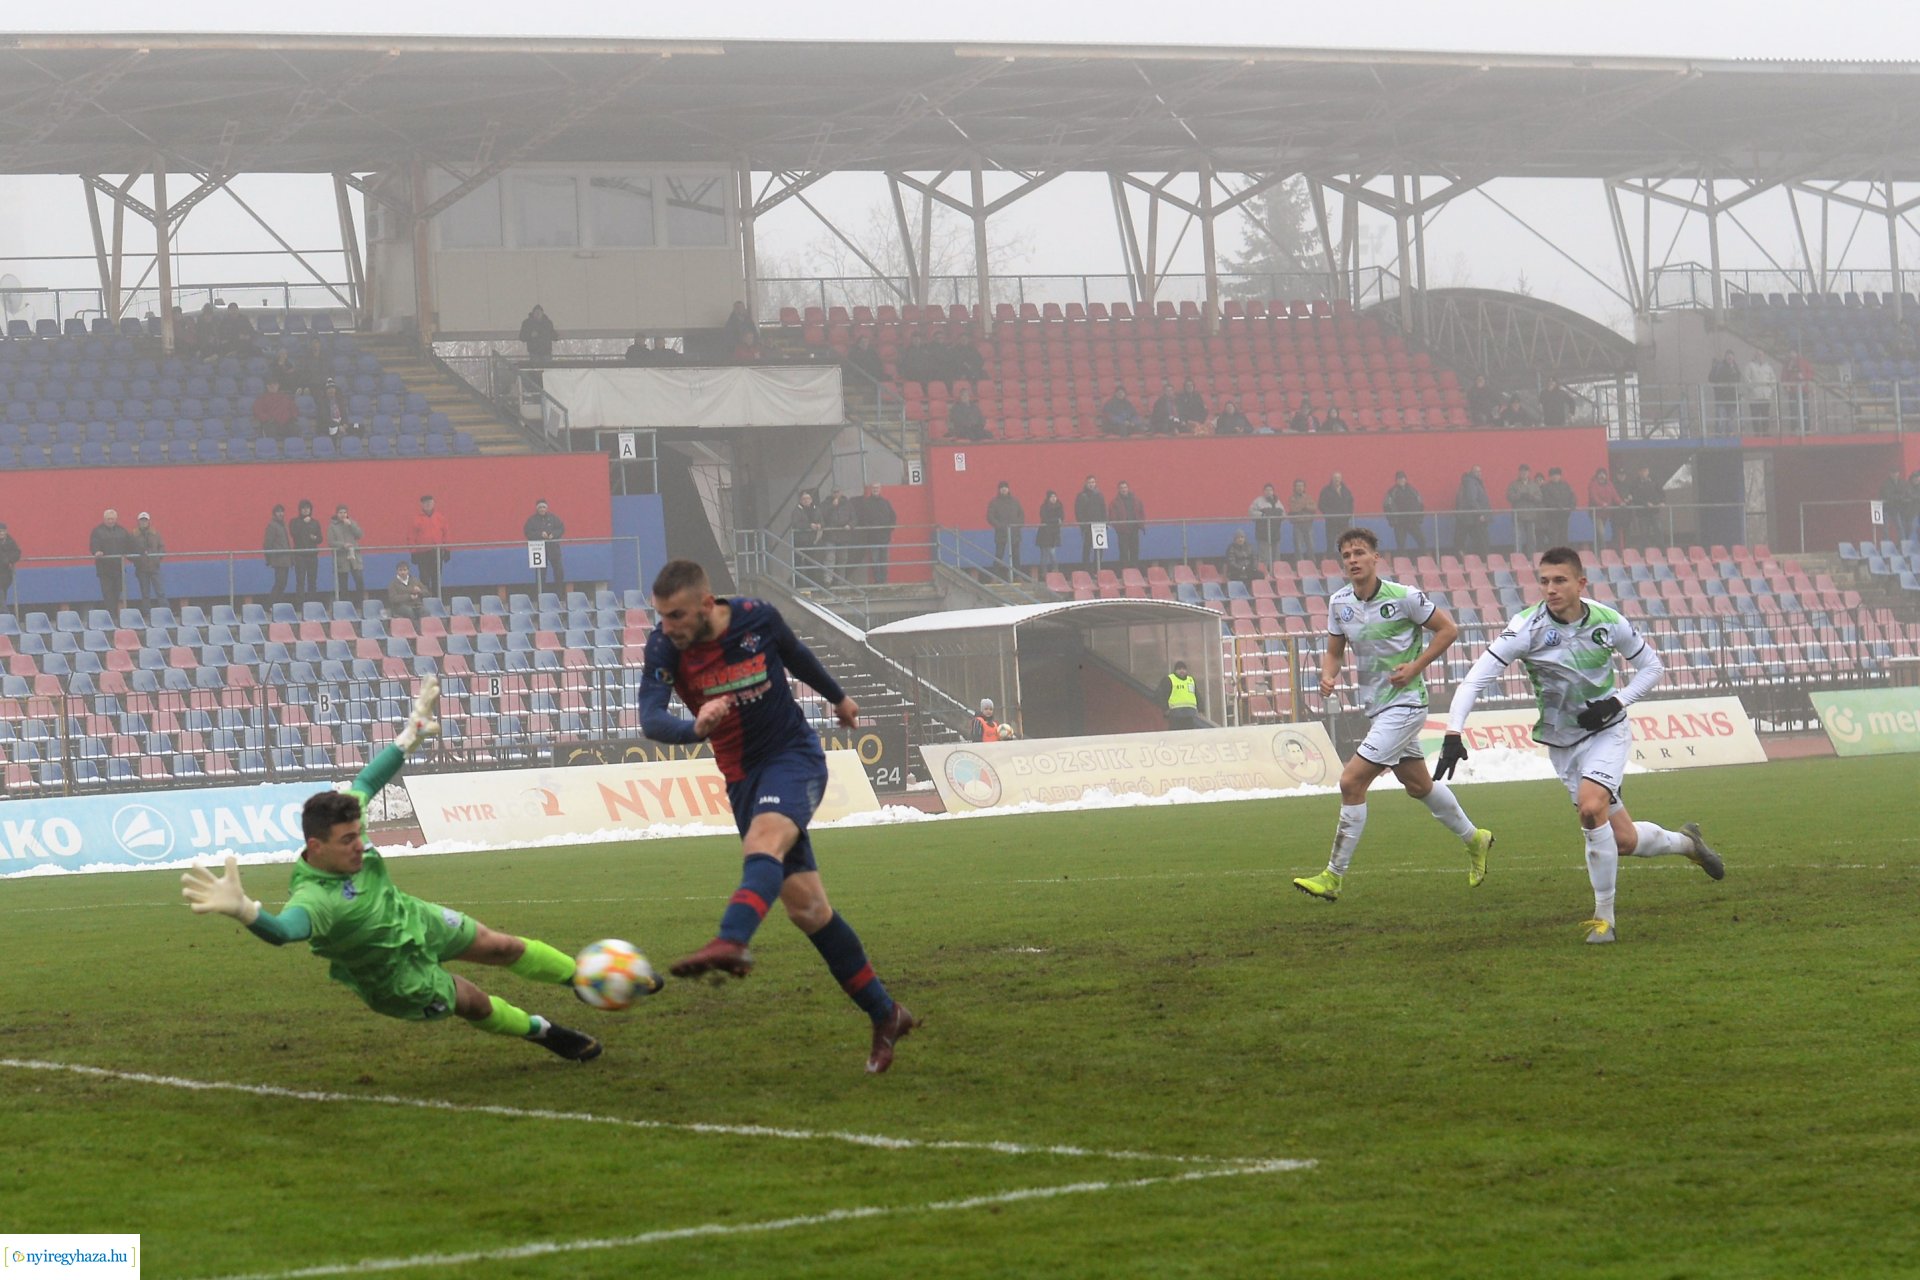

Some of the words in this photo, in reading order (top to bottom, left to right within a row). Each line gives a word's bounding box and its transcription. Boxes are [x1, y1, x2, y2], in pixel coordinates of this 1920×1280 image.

[623, 443, 633, 456] A
[912, 470, 921, 483] B
[1095, 533, 1104, 547] C
[532, 552, 542, 565] B
[490, 678, 500, 696] B
[320, 694, 329, 712] B
[1012, 747, 1134, 776] BOZSIK
[1139, 740, 1251, 768] JÓZSEF
[0, 816, 83, 860] KO
